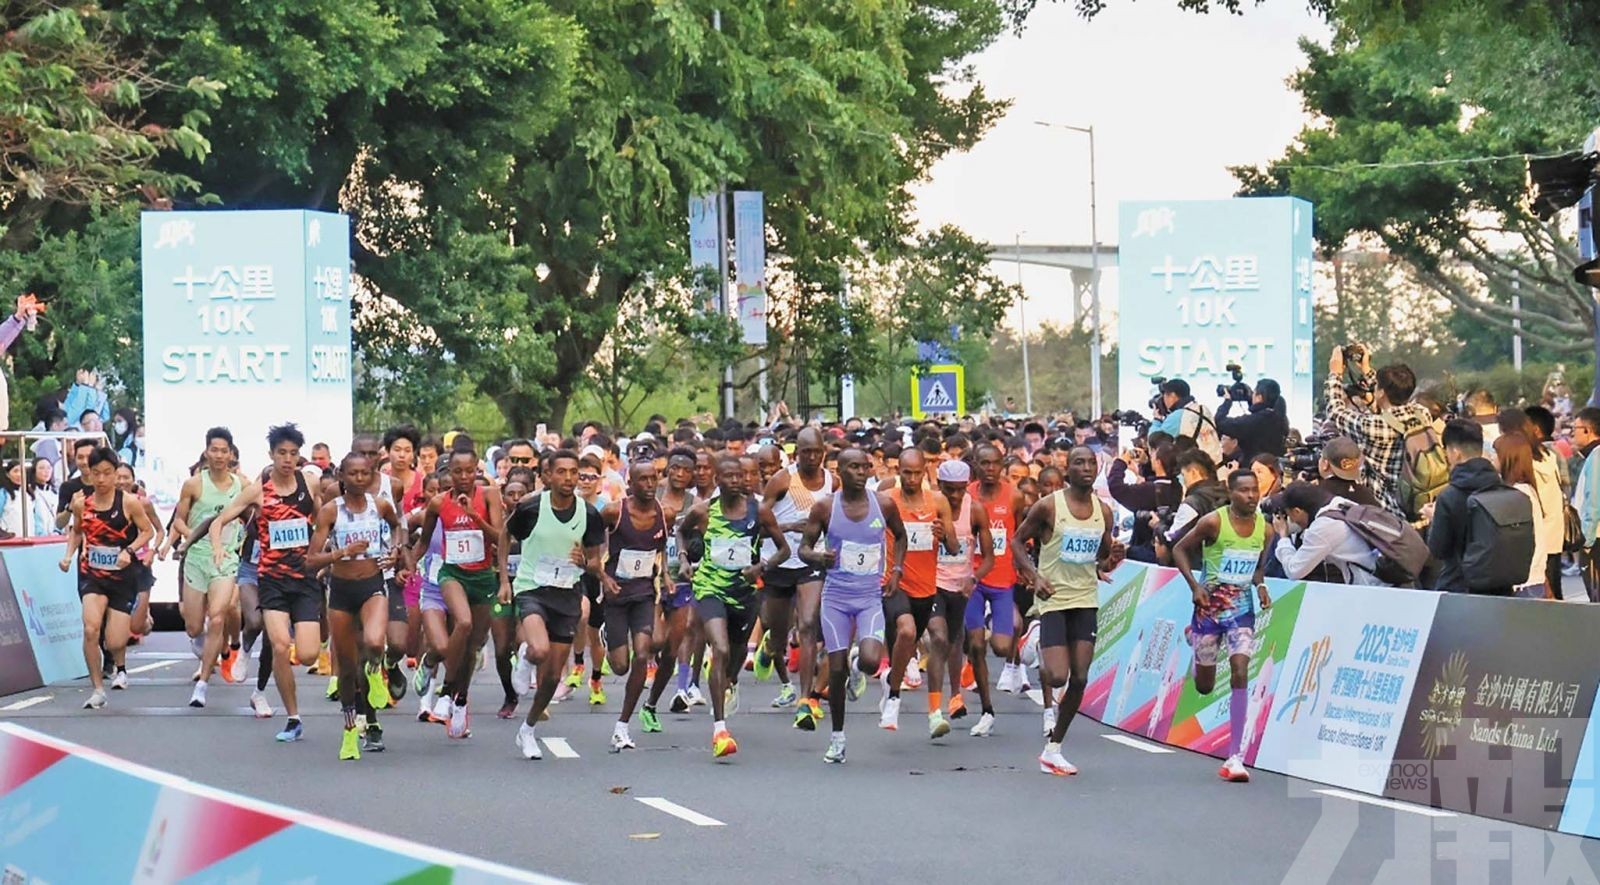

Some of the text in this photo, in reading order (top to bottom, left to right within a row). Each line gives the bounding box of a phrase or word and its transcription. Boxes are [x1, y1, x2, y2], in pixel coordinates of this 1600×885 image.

[172, 264, 276, 302] 十公里
[1151, 255, 1260, 293] 十公里
[197, 304, 255, 335] 10K
[1176, 297, 1238, 327] 10K
[162, 344, 290, 383] START
[1137, 337, 1275, 378] START
[457, 540, 470, 553] 51
[910, 532, 917, 544] 4
[634, 560, 641, 571] 8
[727, 548, 735, 561] 2
[857, 553, 865, 566] 3
[554, 567, 560, 579] 1
[1354, 624, 1394, 664] 2025
[1474, 673, 1580, 718] 金沙中國有限公司
[1470, 718, 1501, 744] Sands
[1504, 722, 1534, 751] China
[1536, 727, 1559, 753] Ltd.
